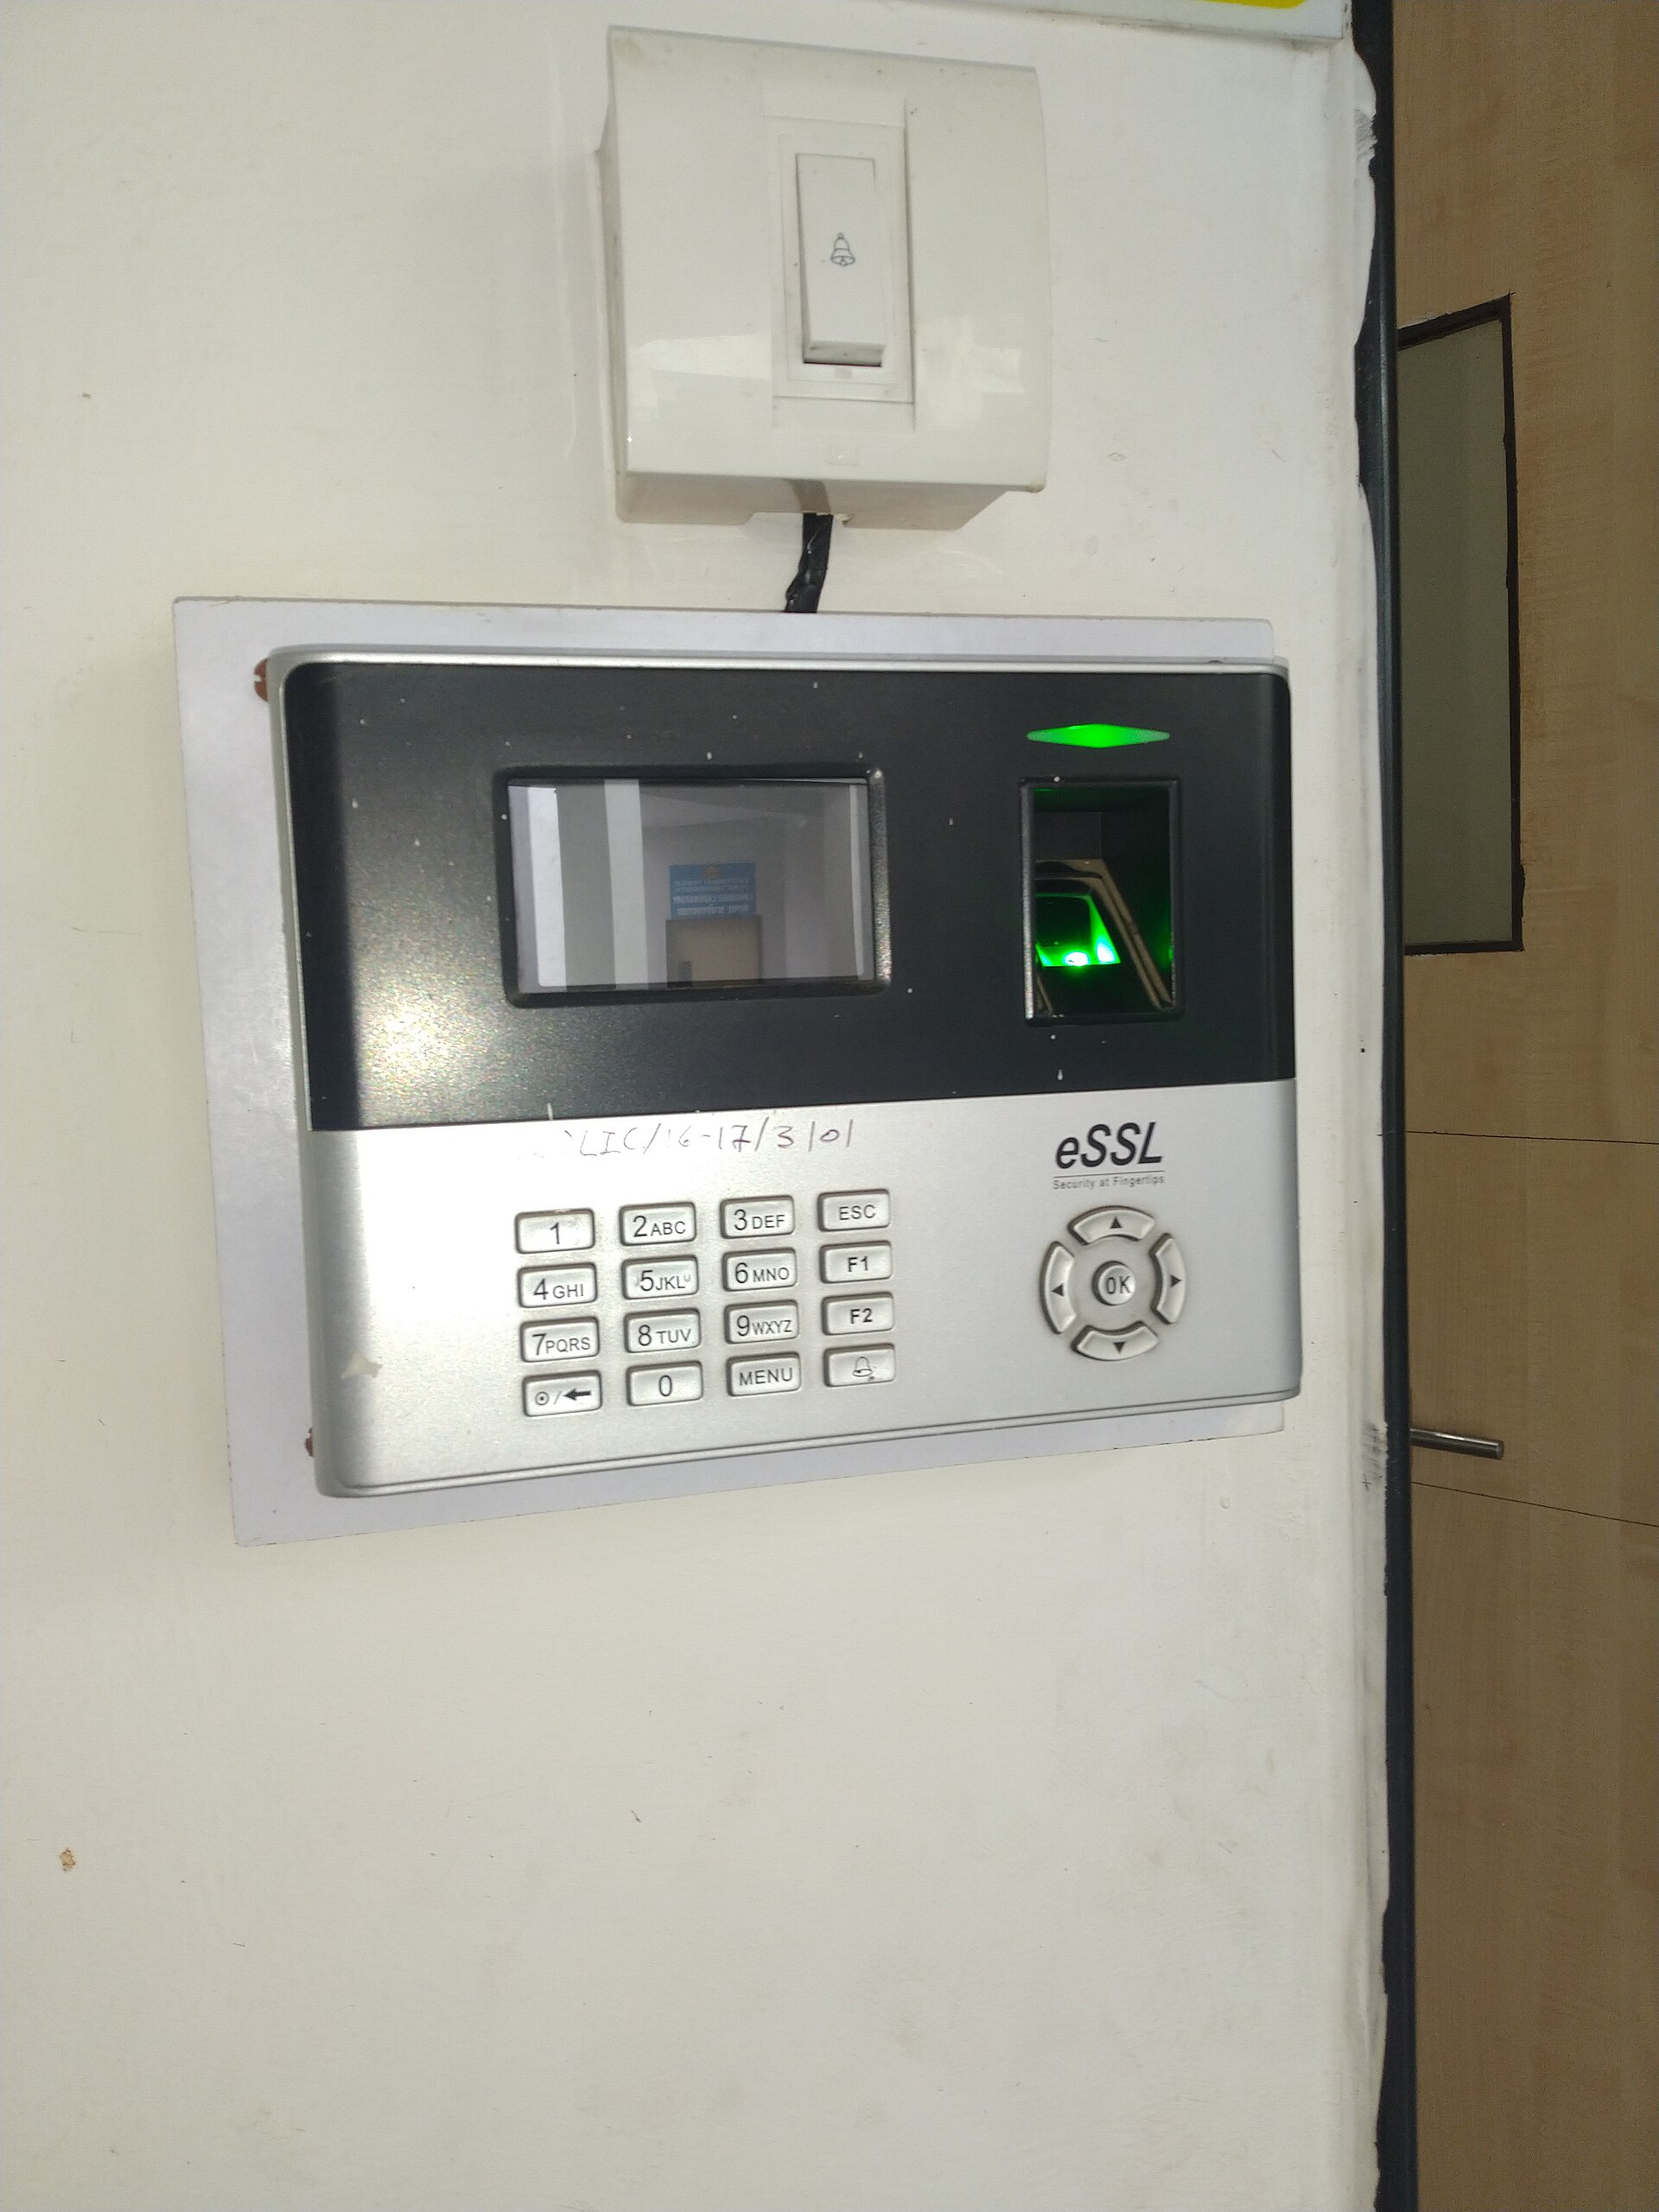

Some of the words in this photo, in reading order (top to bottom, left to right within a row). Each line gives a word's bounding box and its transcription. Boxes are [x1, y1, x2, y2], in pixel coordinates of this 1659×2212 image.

[1055, 1122, 1163, 1169] eSSL
[1052, 1179, 1095, 1190] Security
[1099, 1178, 1109, 1187] at
[1113, 1175, 1165, 1188] Fingertips
[838, 1205, 876, 1220] ESC
[549, 1221, 563, 1245] 1
[847, 1256, 869, 1273] F1
[1105, 1274, 1132, 1295] OK
[849, 1307, 873, 1325] F2
[658, 1375, 672, 1397] 0
[739, 1367, 793, 1386] MENU
